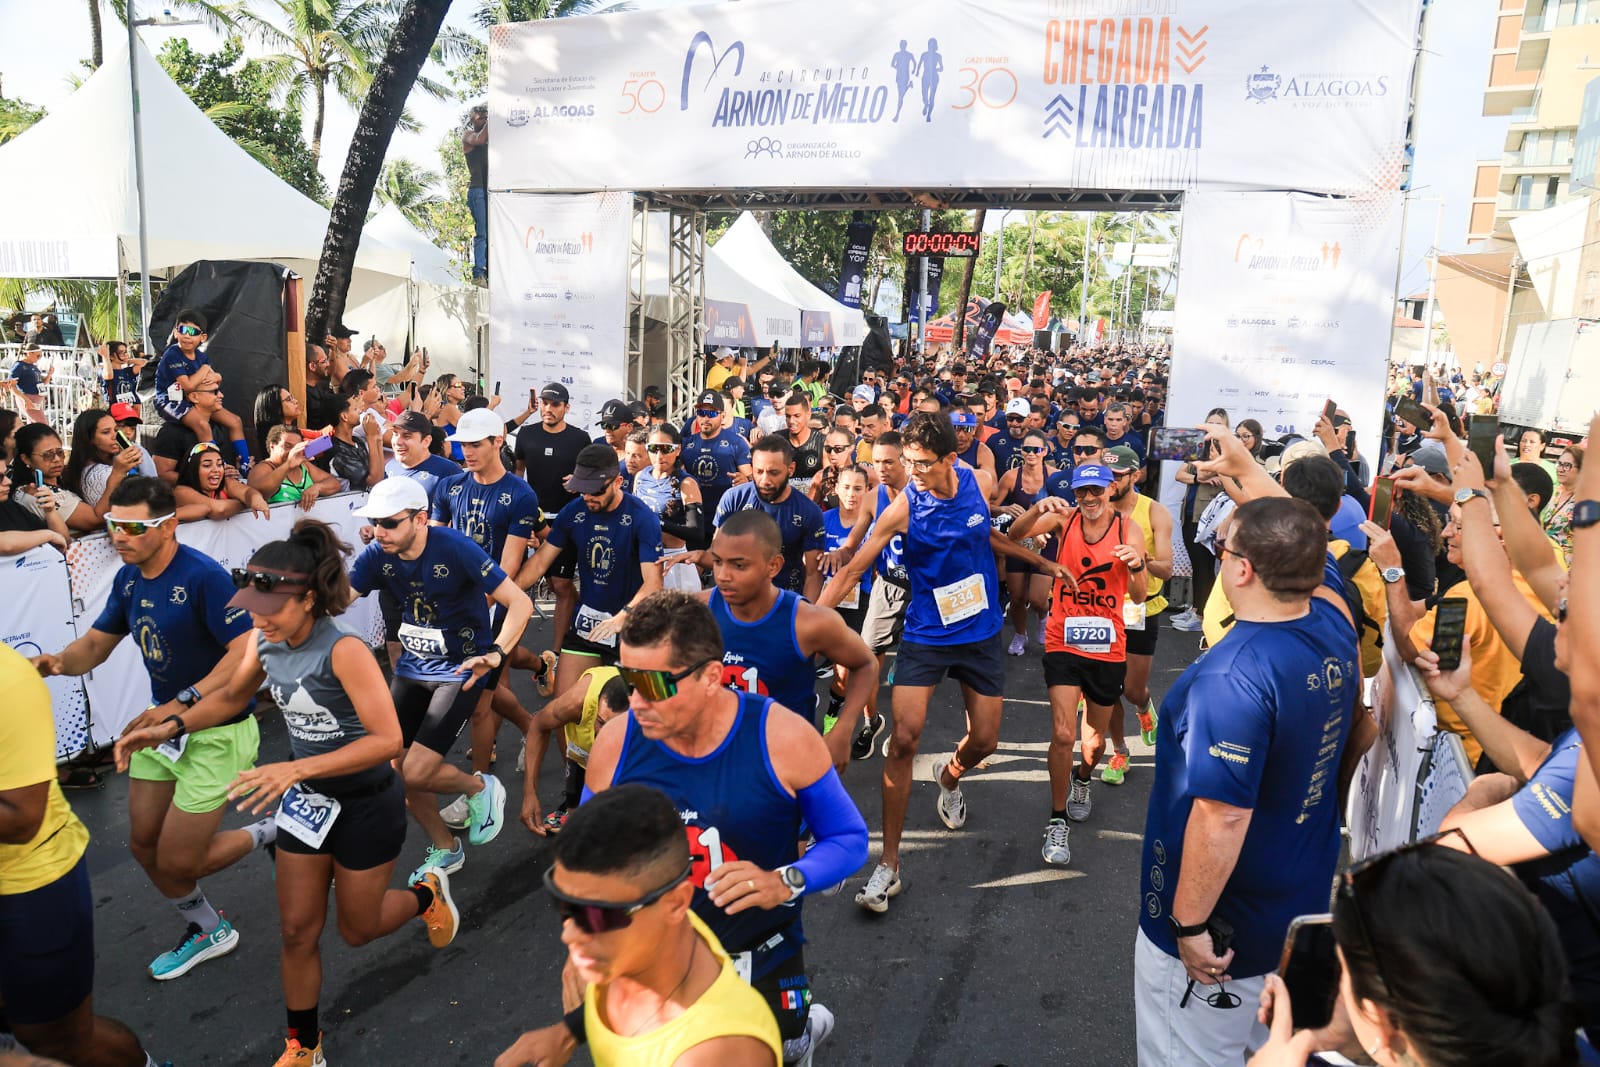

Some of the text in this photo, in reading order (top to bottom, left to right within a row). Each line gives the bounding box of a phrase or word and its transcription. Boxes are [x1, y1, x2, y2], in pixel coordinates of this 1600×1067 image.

[1043, 17, 1171, 85] CHEGADA
[777, 66, 869, 83] CIRCUITO
[951, 67, 1019, 110] 30
[1284, 76, 1389, 97] ALAGOAS
[617, 79, 666, 114] 50
[712, 82, 889, 128] ARNON DE MELLO
[533, 105, 595, 119] ALAGOAS
[1075, 84, 1204, 149] LARGADA
[785, 149, 861, 159] ARNON DE MELLO
[786, 141, 838, 151] ORGANIZAÇÃO
[905, 234, 978, 252] 00:00:04
[19, 241, 70, 272] VOLUMES
[1248, 255, 1280, 270] ARNON
[1289, 256, 1320, 271] MELLO
[1241, 318, 1277, 326] ALAGOAS
[169, 587, 187, 602] 30
[949, 589, 975, 608] 234
[1072, 627, 1106, 640] 3720
[406, 636, 436, 653] 2921
[722, 651, 744, 664] Equipe
